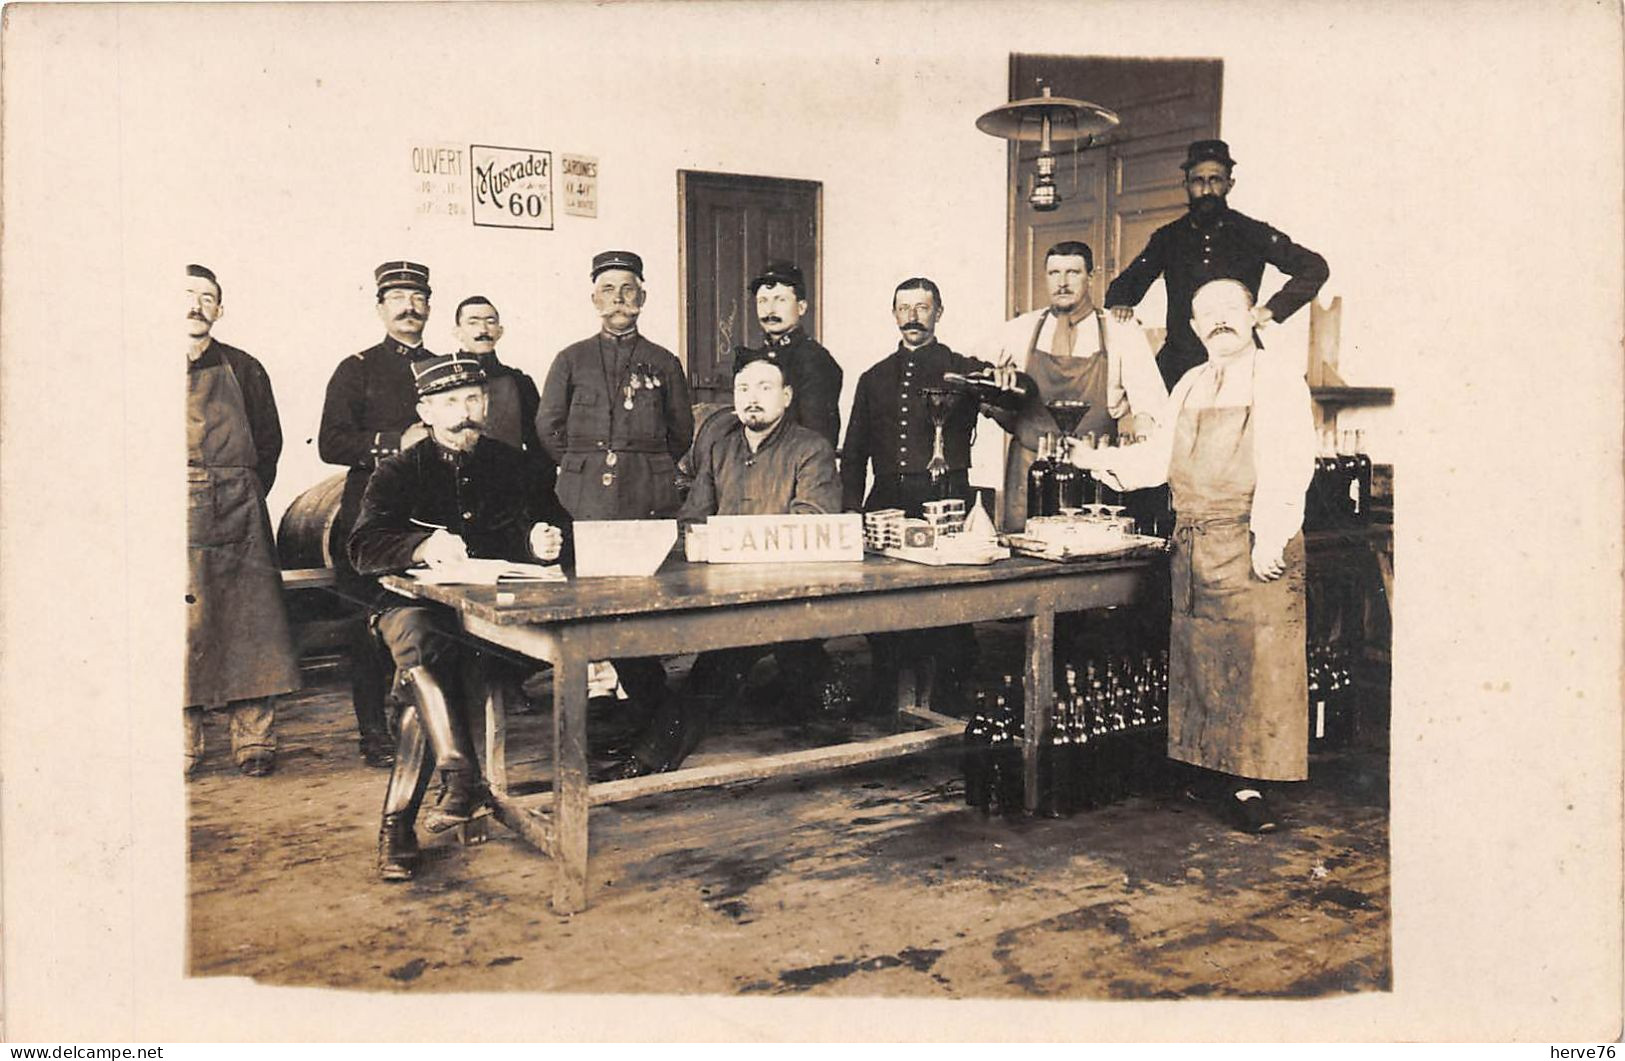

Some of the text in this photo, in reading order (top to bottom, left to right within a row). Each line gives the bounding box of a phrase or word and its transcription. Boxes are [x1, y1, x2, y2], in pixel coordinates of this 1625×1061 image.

[412, 147, 463, 176] OUVERT
[562, 158, 597, 178] SARDINES
[475, 154, 548, 209] Muscadet
[718, 523, 852, 552] CANTINE
